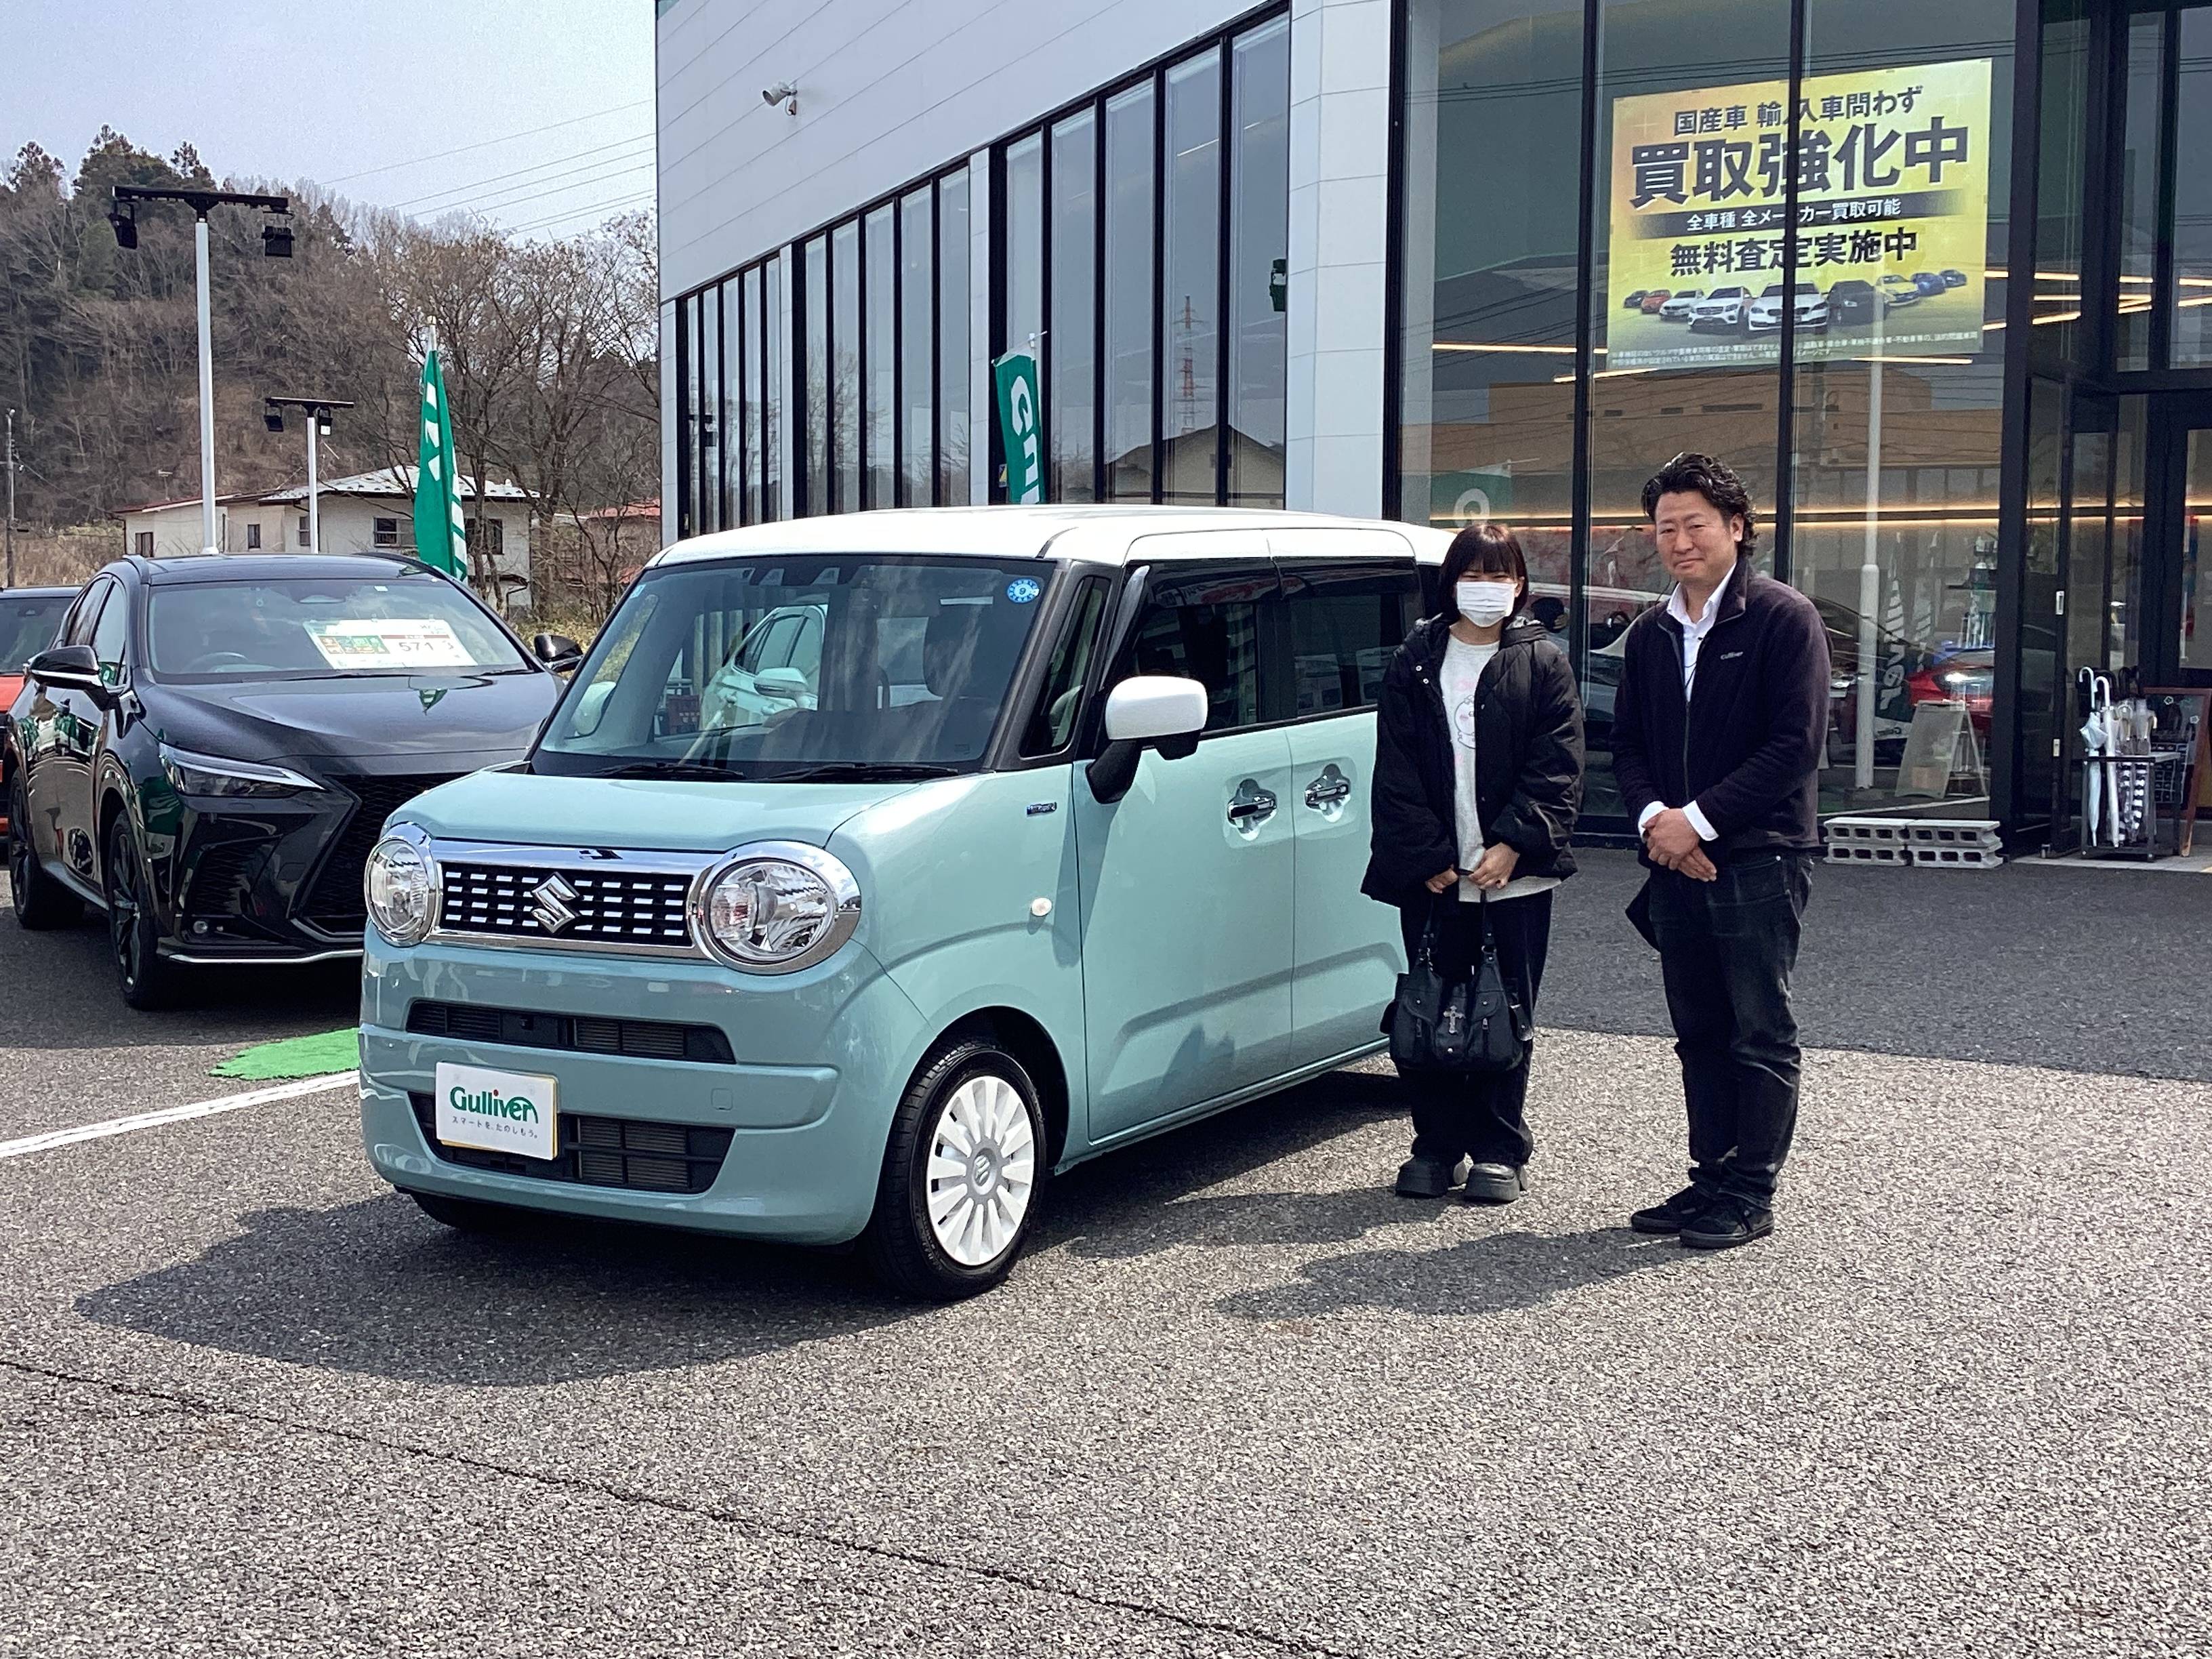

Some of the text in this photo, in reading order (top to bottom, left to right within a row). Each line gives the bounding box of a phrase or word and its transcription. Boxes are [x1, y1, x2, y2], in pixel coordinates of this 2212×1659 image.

[1674, 85, 1923, 136] 国産車 輸入車問わず
[1629, 116, 1968, 211] 買取強化中
[1686, 198, 1902, 232] 全車種 全メーカー買取可能
[1670, 227, 1918, 277] 無料査定実施中
[450, 1086, 539, 1124] Gulliver
